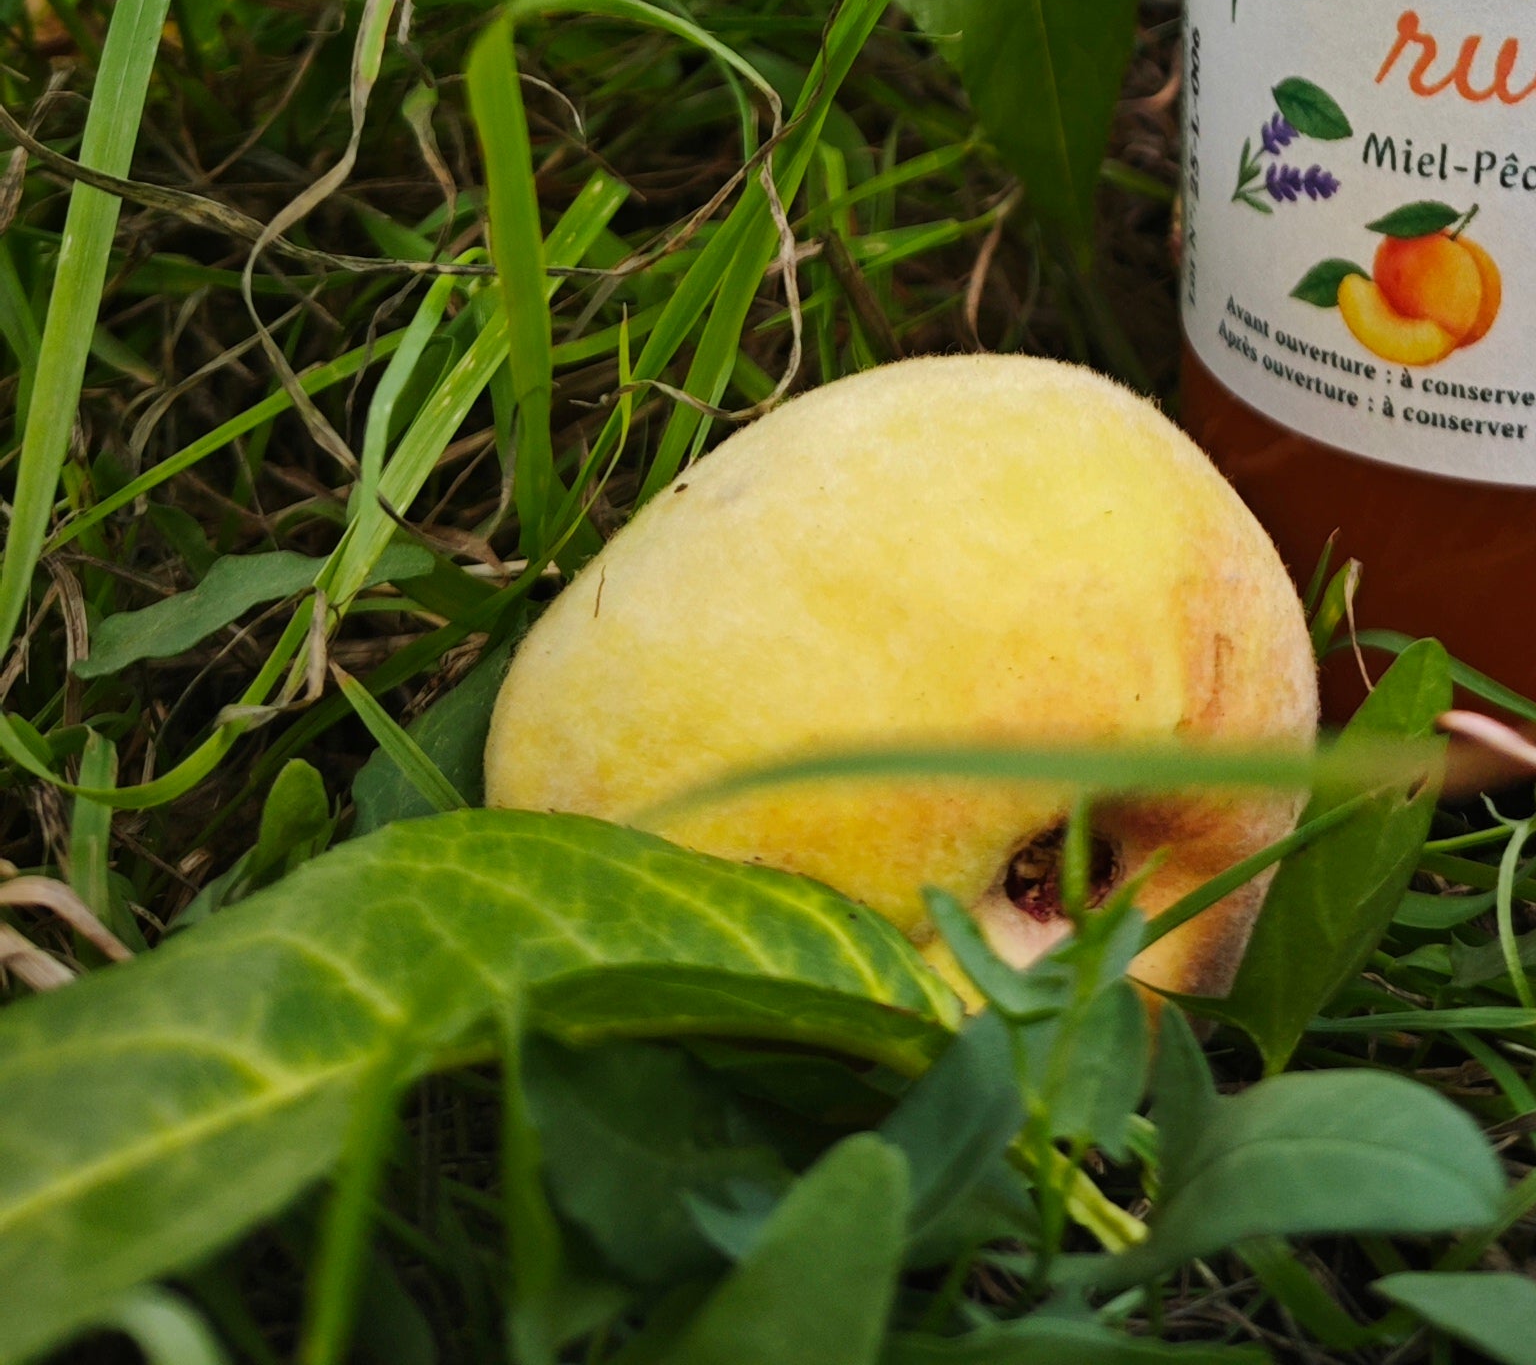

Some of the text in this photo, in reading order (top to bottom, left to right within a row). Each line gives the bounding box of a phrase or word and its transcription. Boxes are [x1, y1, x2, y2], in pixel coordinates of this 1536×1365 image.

[1218, 318, 1258, 362] Après
[1262, 353, 1359, 406] ouverture
[1382, 395, 1395, 418] à
[1402, 406, 1527, 439] conserver
[1226, 294, 1269, 337] Avant
[1275, 329, 1377, 381] ouverture
[1401, 367, 1414, 389] à
